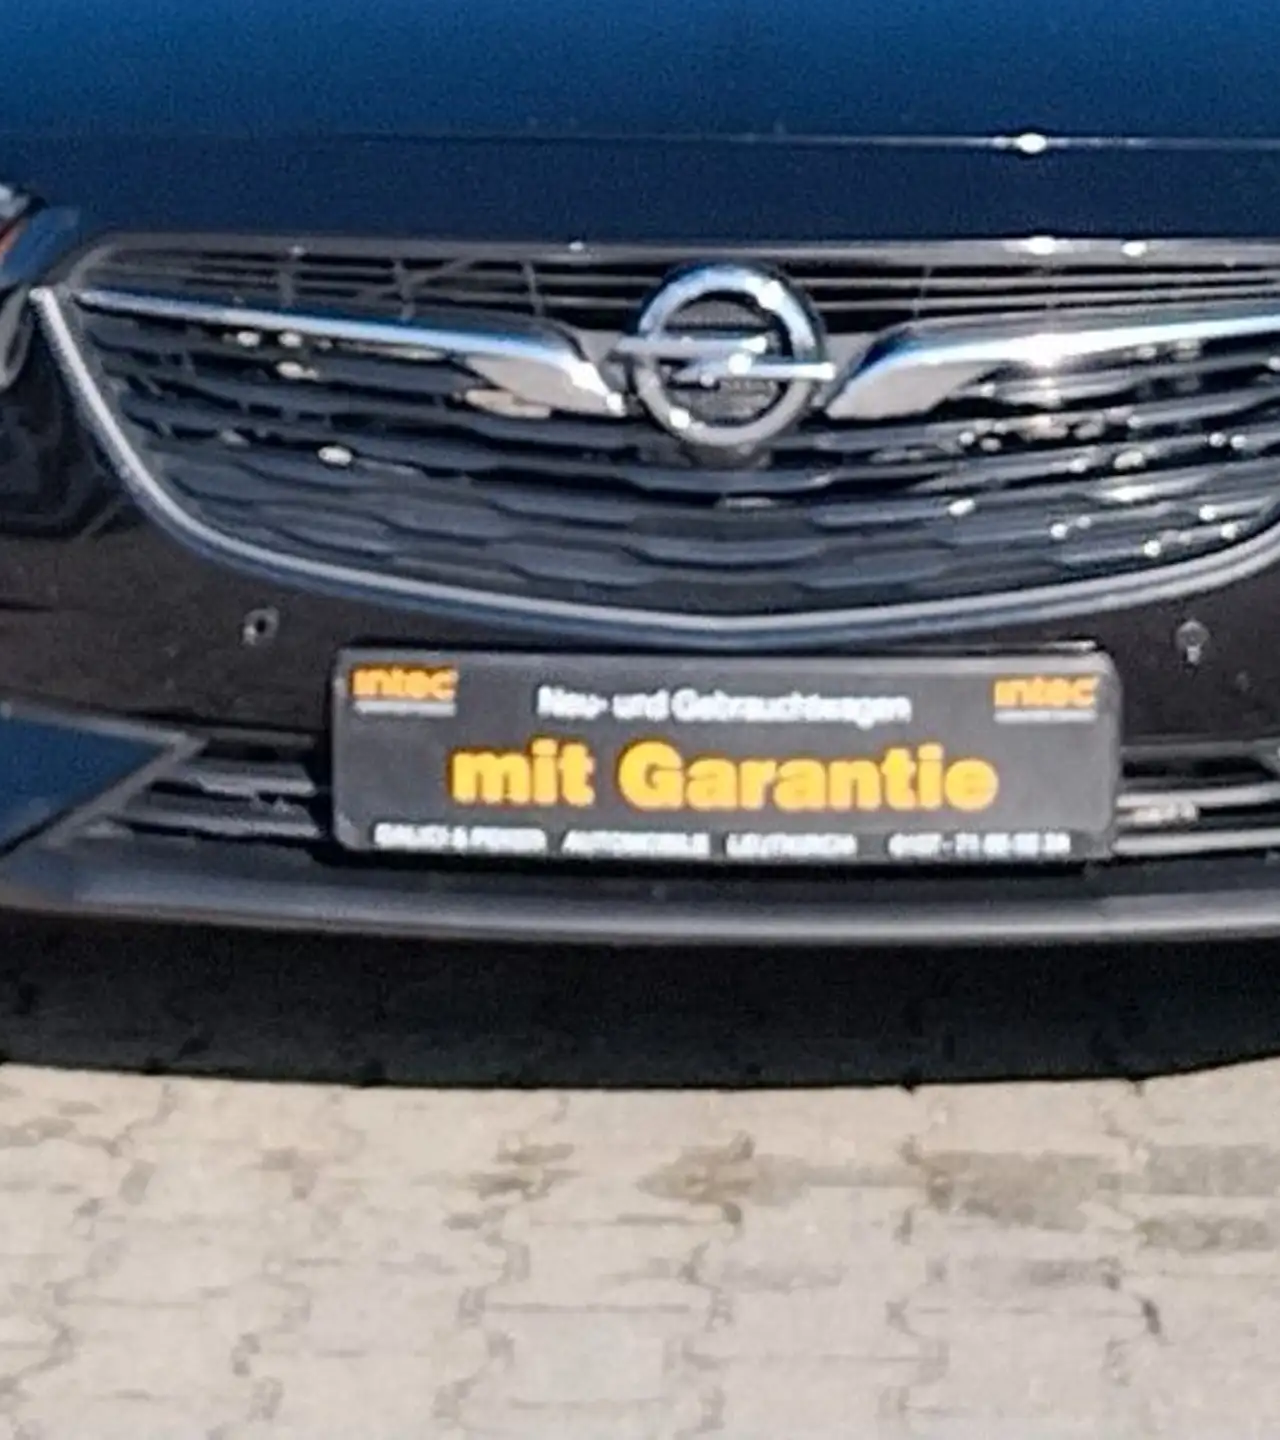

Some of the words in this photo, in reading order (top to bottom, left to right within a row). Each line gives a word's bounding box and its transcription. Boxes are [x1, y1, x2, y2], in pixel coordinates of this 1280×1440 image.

[612, 689, 670, 721] und
[451, 736, 596, 808] mit
[617, 739, 1000, 812] Garantie
